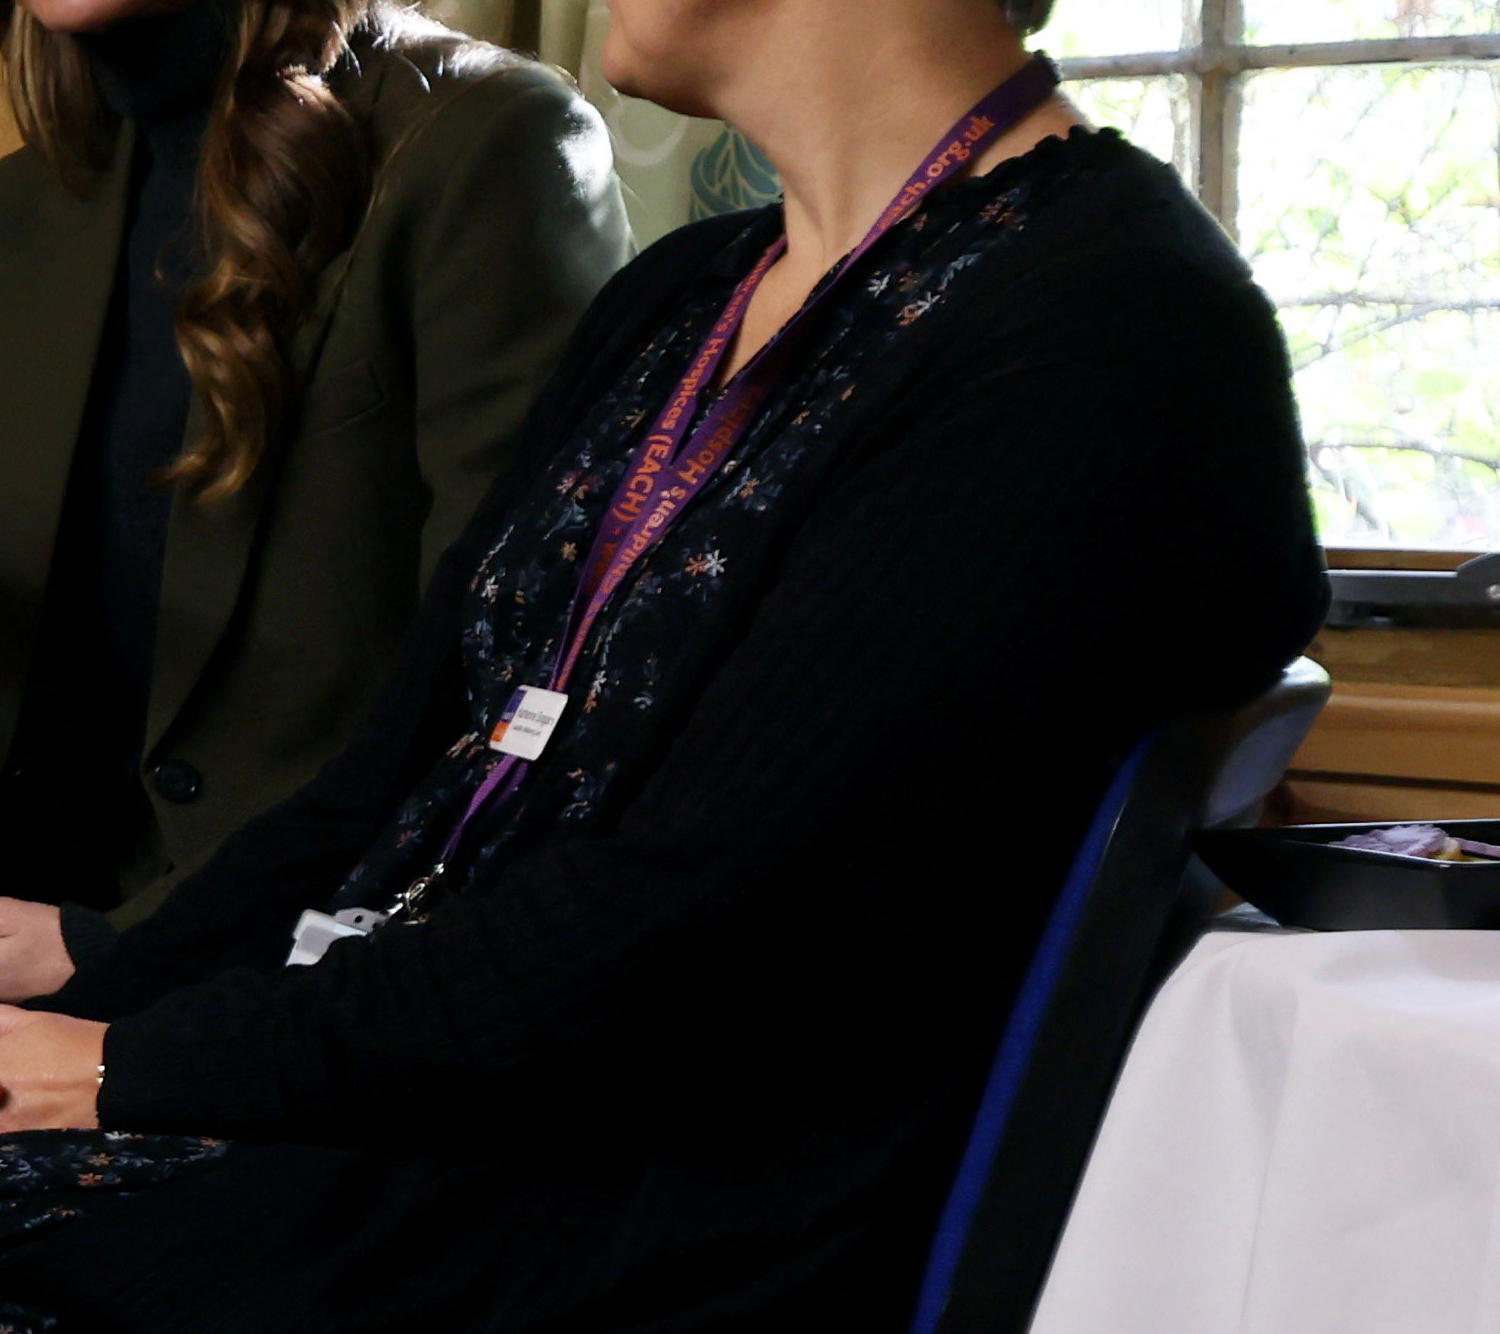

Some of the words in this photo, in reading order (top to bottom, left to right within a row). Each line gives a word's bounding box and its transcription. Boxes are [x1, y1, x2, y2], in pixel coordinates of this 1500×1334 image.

[662, 338, 726, 430] Hospices
[611, 433, 674, 523] (EACH)
[601, 486, 687, 595] Children's
